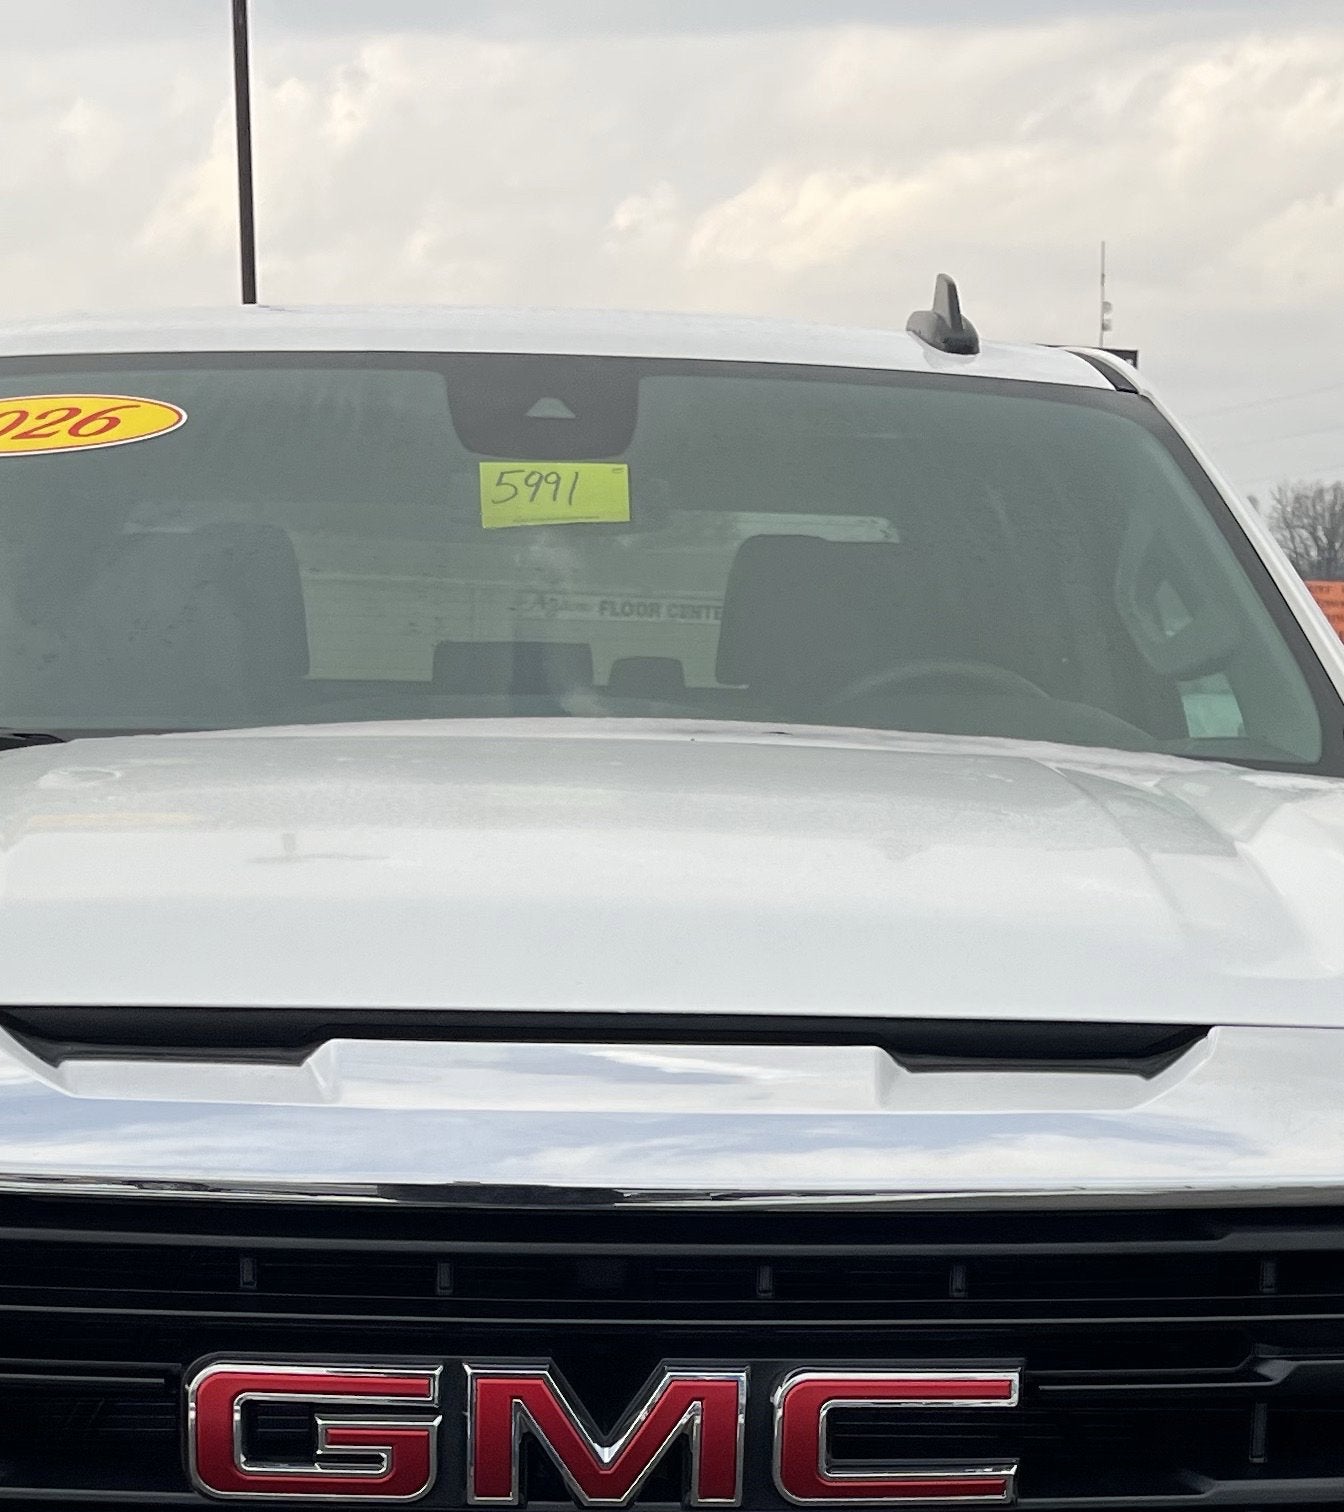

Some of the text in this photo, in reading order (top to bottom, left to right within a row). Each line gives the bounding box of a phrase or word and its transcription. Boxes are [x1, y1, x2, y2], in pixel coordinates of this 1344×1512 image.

[491, 469, 579, 506] 5991
[599, 599, 661, 619] FLOOR
[666, 603, 724, 621] CENTE
[187, 1361, 1022, 1507] GMC
